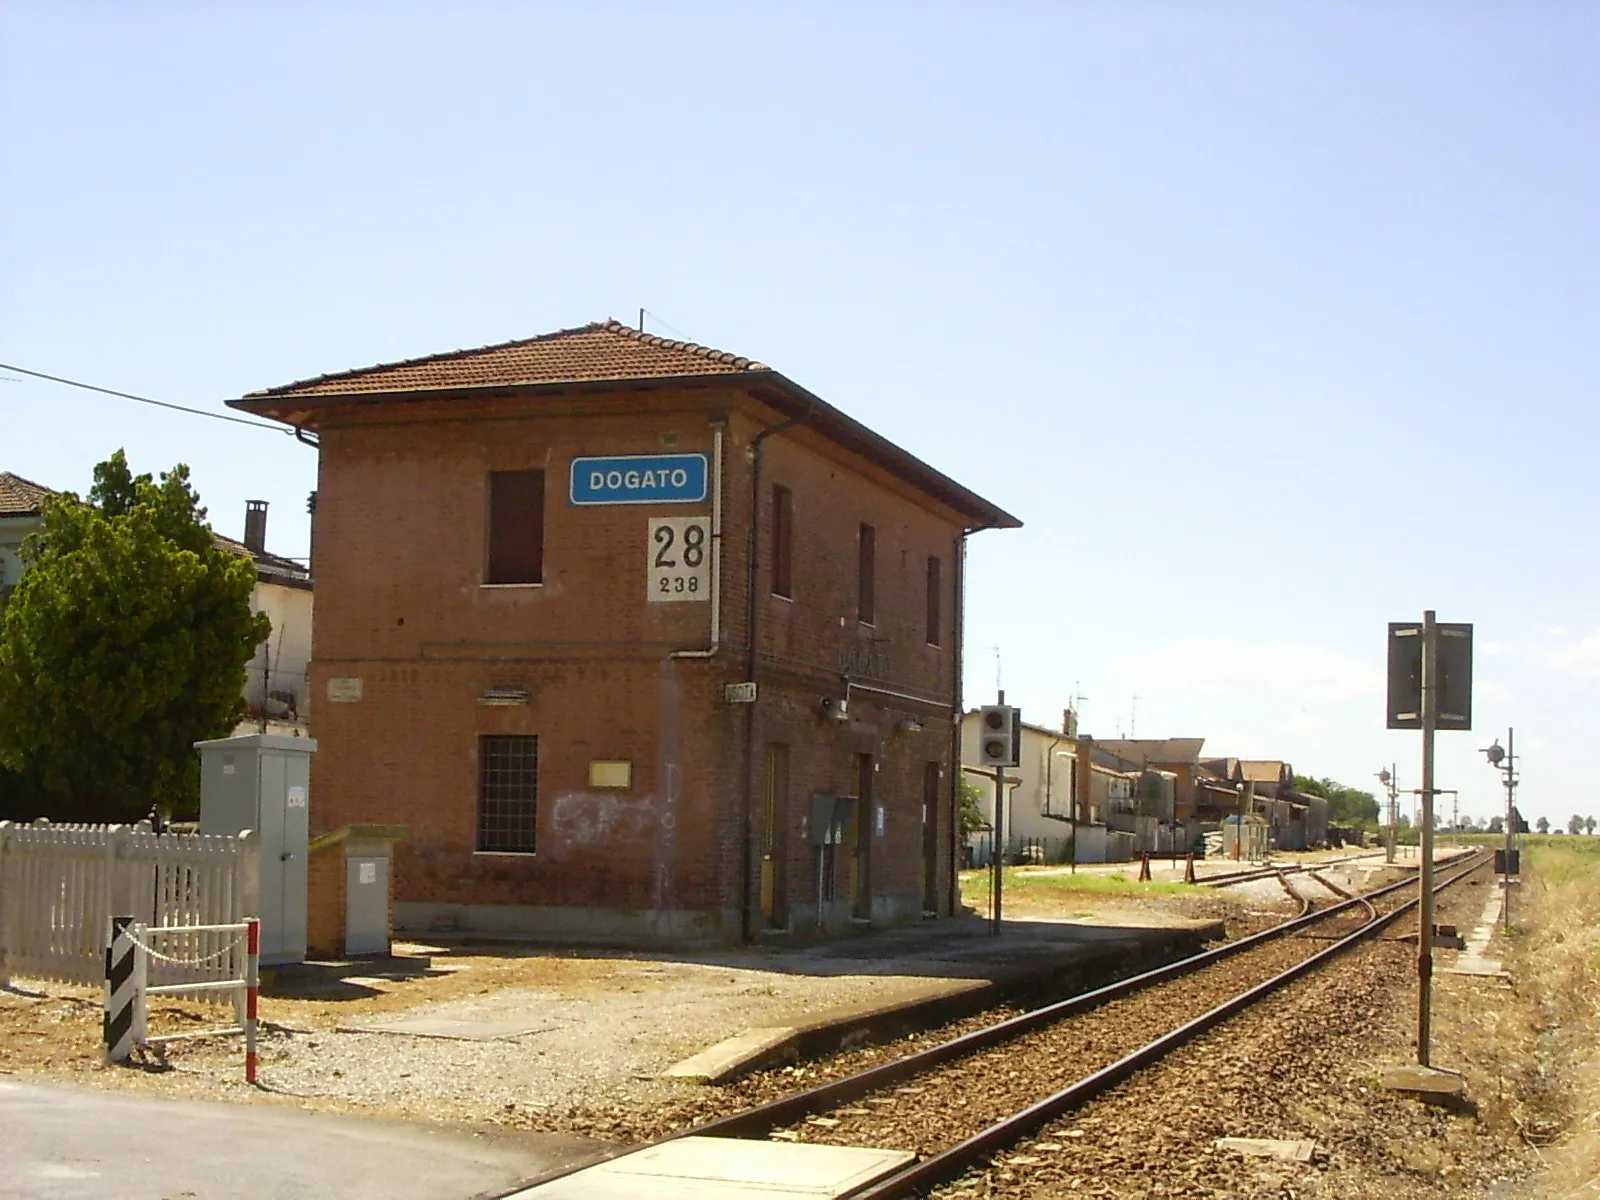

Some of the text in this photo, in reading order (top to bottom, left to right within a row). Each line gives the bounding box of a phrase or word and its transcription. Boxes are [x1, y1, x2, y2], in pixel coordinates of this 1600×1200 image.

[590, 469, 687, 490] DOGATO
[654, 525, 704, 568] 28
[660, 576, 698, 593] 238
